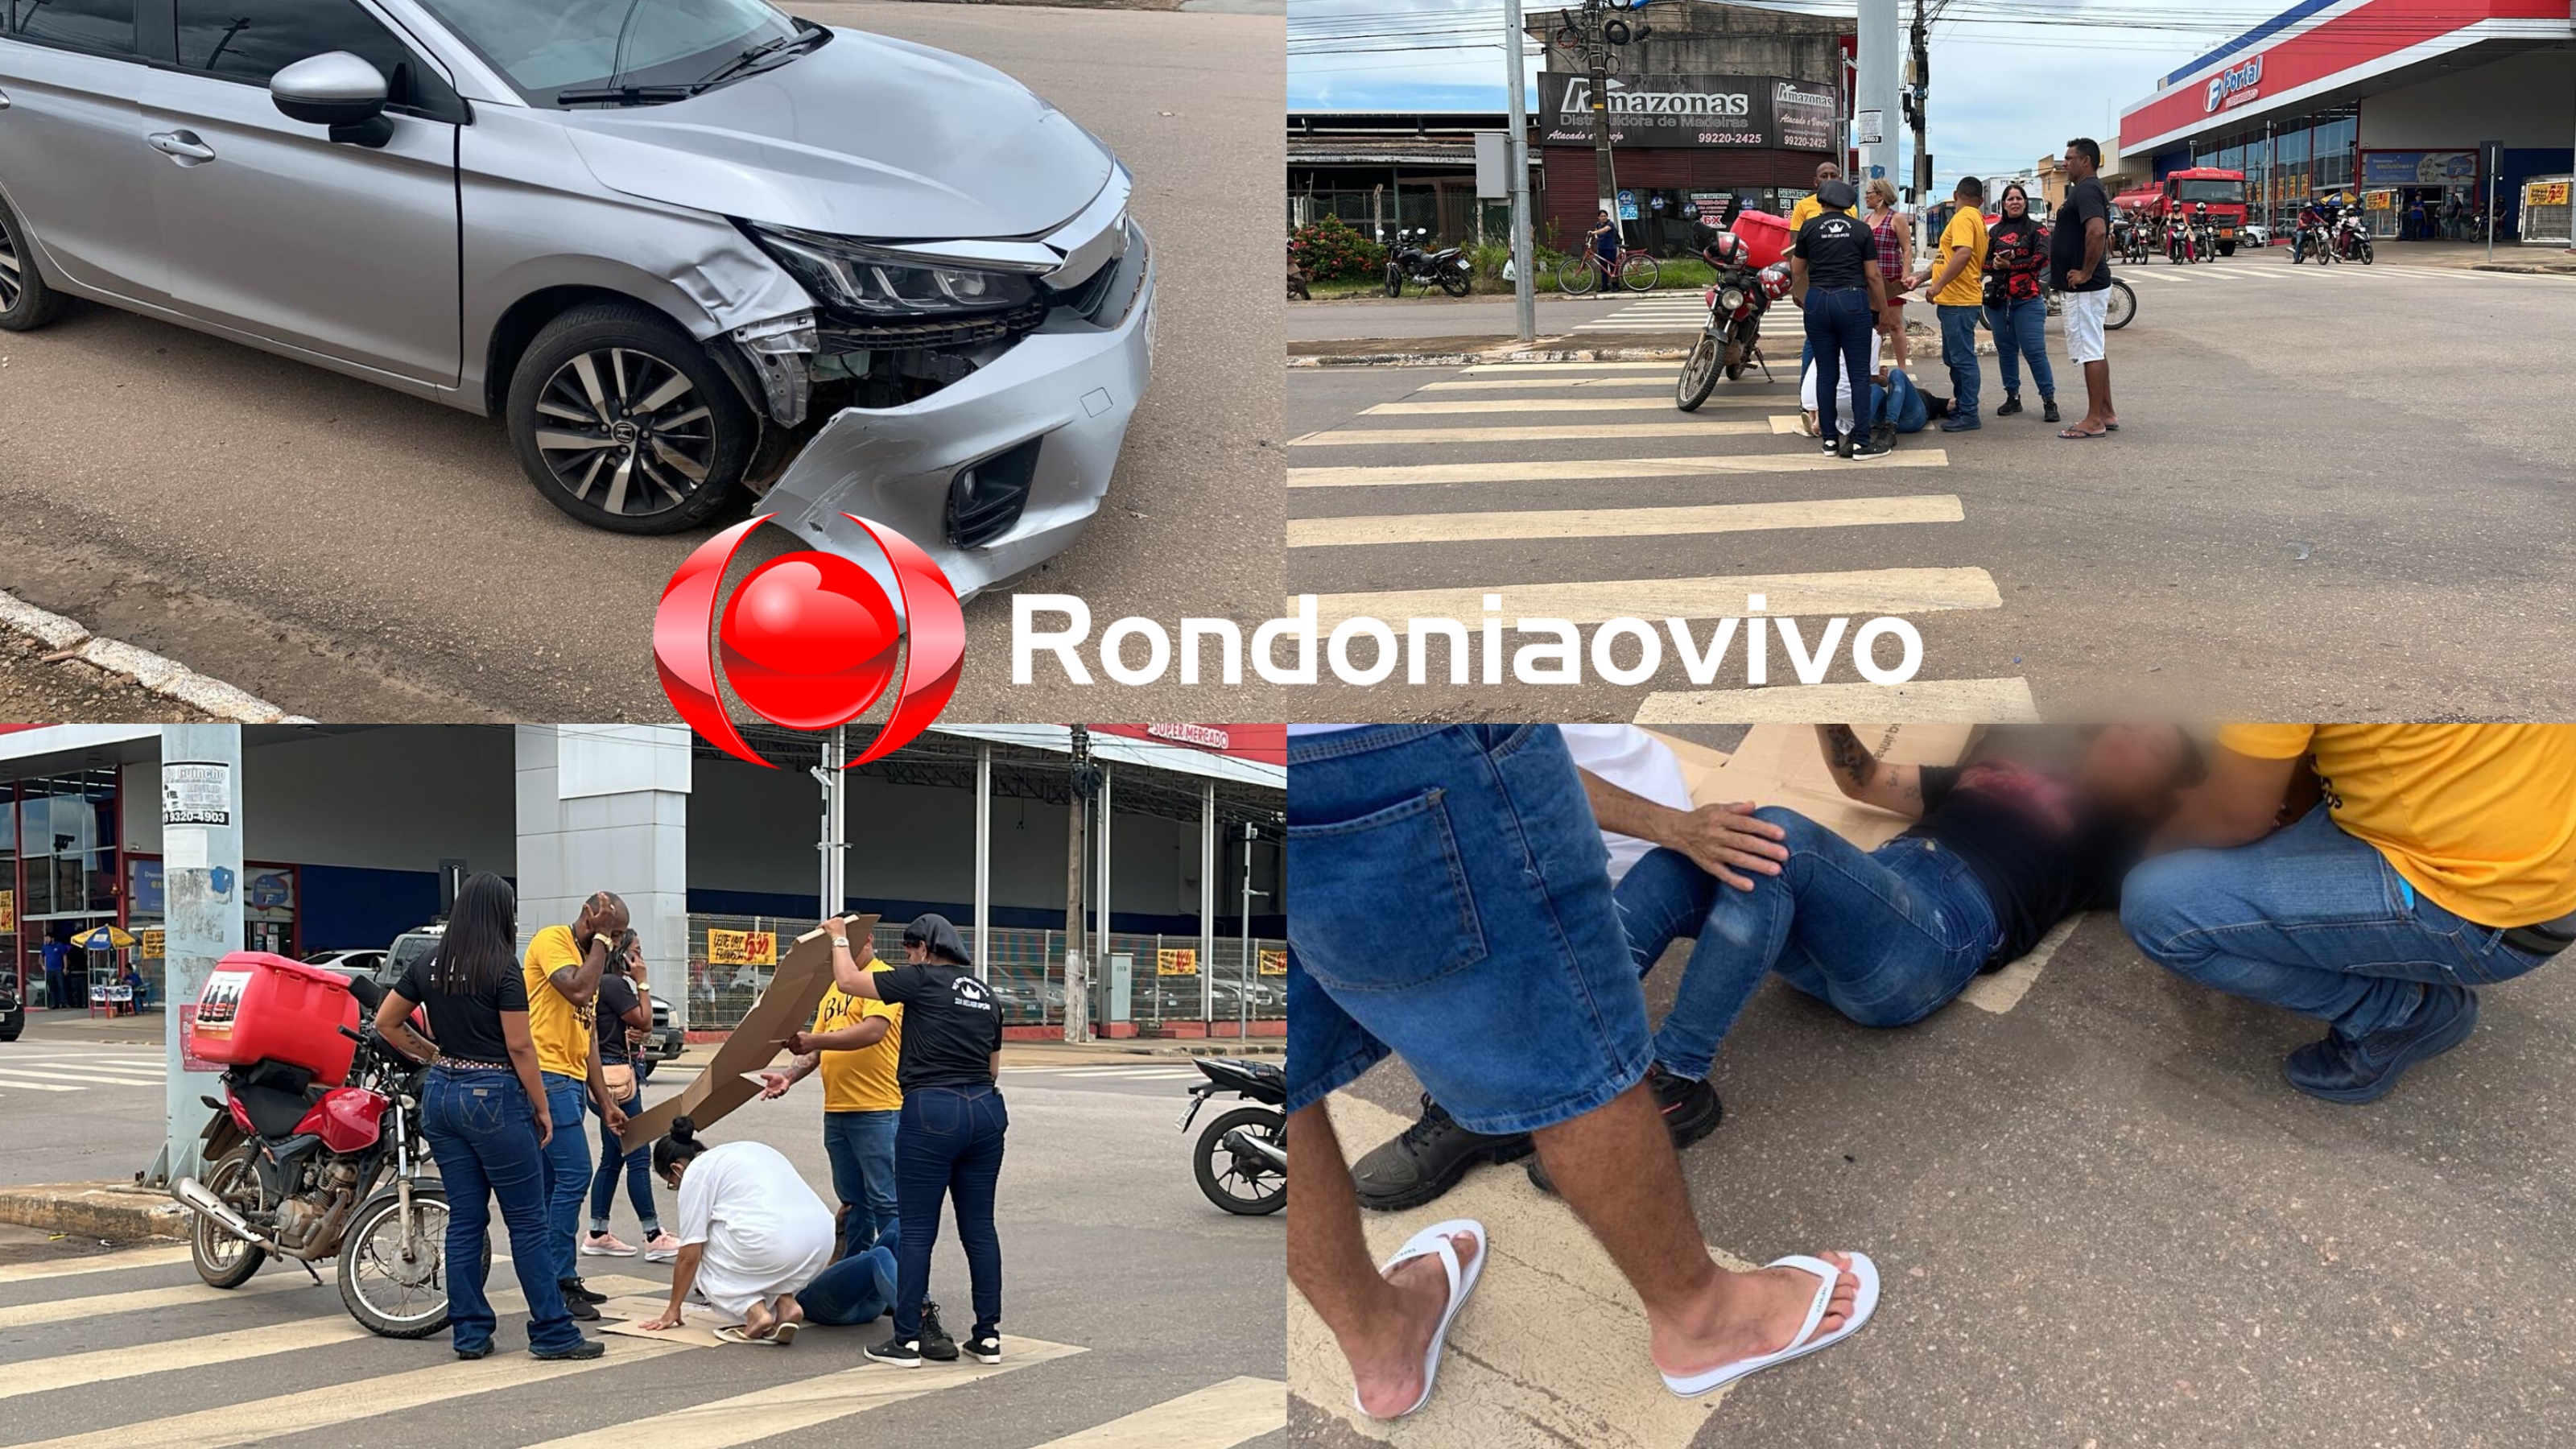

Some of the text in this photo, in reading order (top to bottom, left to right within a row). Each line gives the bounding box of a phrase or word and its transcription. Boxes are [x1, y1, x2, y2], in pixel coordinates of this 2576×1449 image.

[2223, 55, 2263, 98] Fortal
[1560, 77, 1748, 115] Amazonas
[1777, 82, 1833, 107] Amazonas
[1560, 114, 1748, 128] Distruidora de Madeiras
[1779, 114, 1806, 125] Atacado
[1547, 130, 1586, 140] Atacado
[1699, 133, 1762, 144] 99220-2425
[1784, 135, 1827, 148] 99220-2425
[2196, 171, 2234, 179] Mercedes-Benz
[1651, 198, 1664, 206] 44
[1741, 198, 1754, 206] 44
[1703, 215, 1722, 225] 6X
[1153, 724, 1228, 749] SUPER MERCADO
[178, 766, 225, 780] Guincho
[170, 811, 225, 823] 9320-4903
